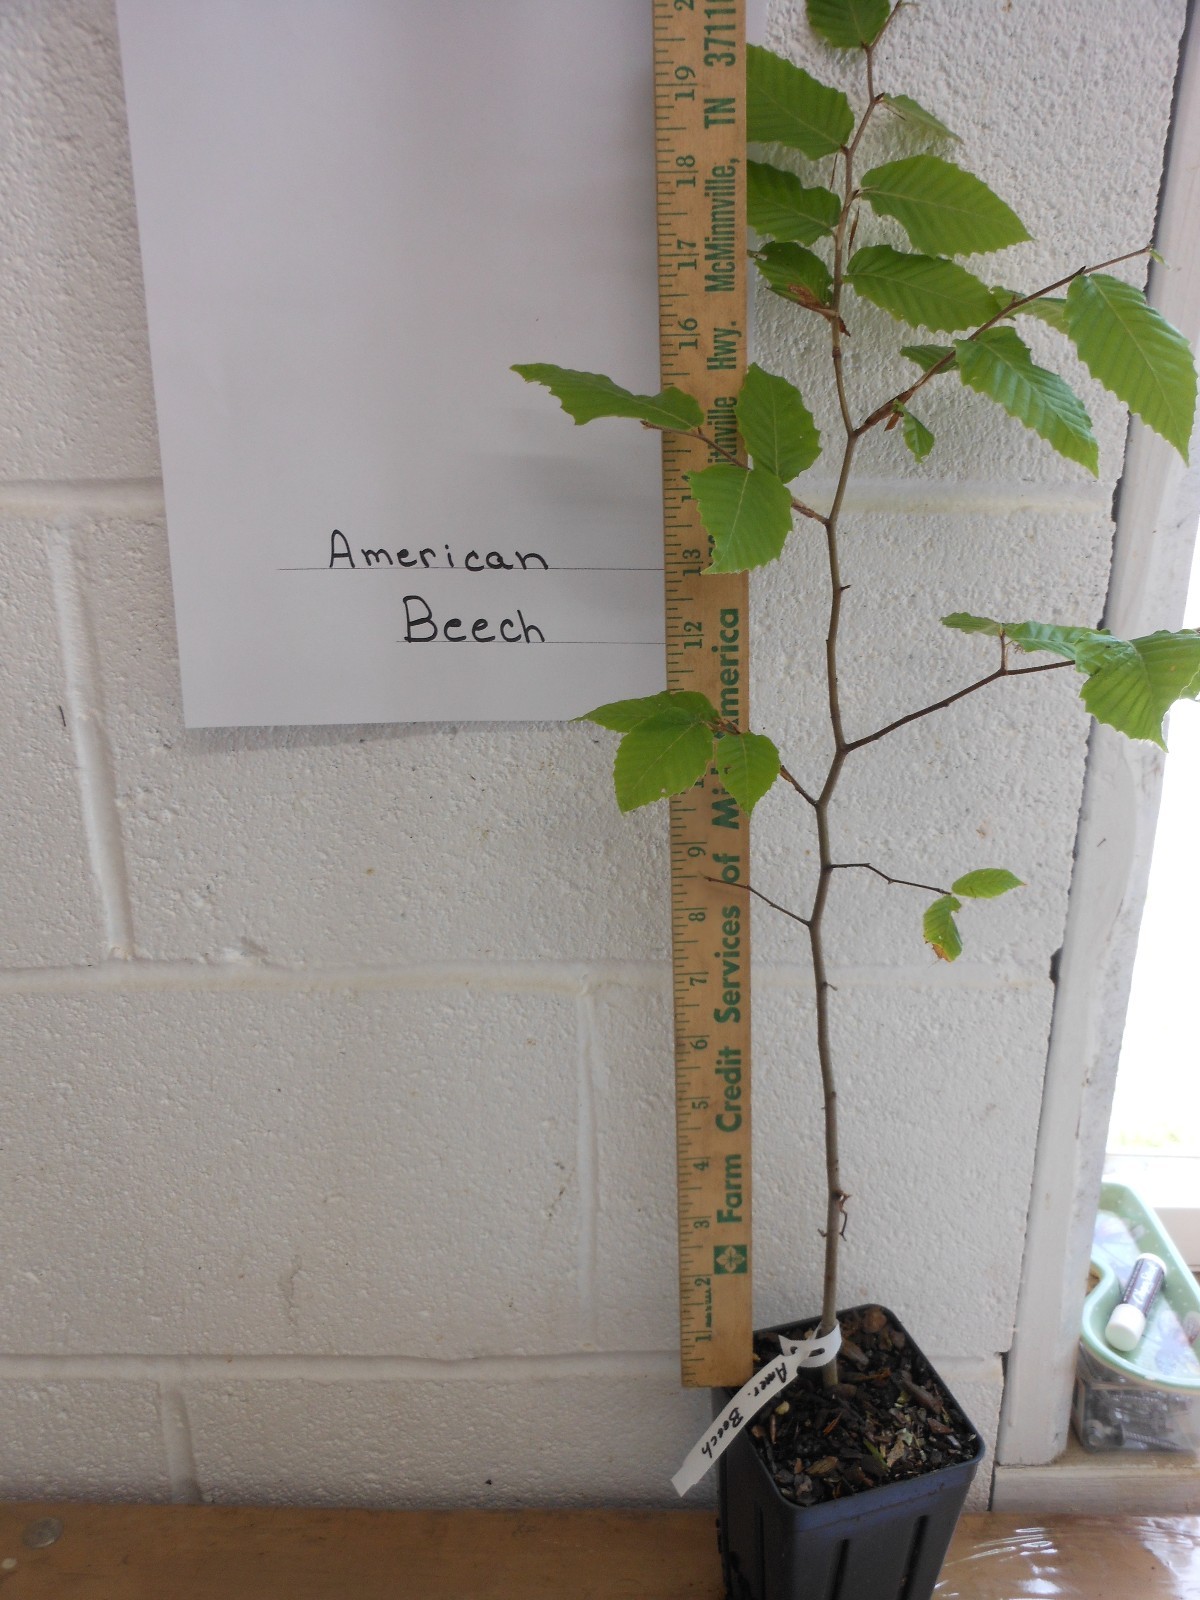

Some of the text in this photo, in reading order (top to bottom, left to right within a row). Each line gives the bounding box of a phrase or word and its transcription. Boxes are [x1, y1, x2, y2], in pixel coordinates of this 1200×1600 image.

[674, 0, 694, 11] 2
[674, 65, 695, 101] 19
[676, 155, 696, 188] 18
[704, 0, 742, 465] ithville Hwy. McMinnville, TN 3711
[677, 239, 698, 270] 17
[678, 317, 698, 350] 16
[329, 529, 549, 571] American
[682, 549, 701, 576] 13
[402, 595, 545, 643] Beech
[684, 621, 702, 649] 12
[688, 846, 706, 858] 9
[712, 853, 740, 883] of
[688, 911, 706, 922] 8
[714, 905, 741, 1023] Services
[690, 976, 707, 987] 7
[690, 1039, 708, 1050] 6
[715, 1046, 742, 1132] Credit
[691, 1101, 709, 1110] 5
[693, 1160, 709, 1171] 4
[717, 1154, 742, 1223] Farm
[693, 1220, 710, 1229] 3
[694, 1277, 711, 1286] 2
[695, 1333, 711, 1342] 1
[701, 1362, 788, 1459] Amer. Beech
